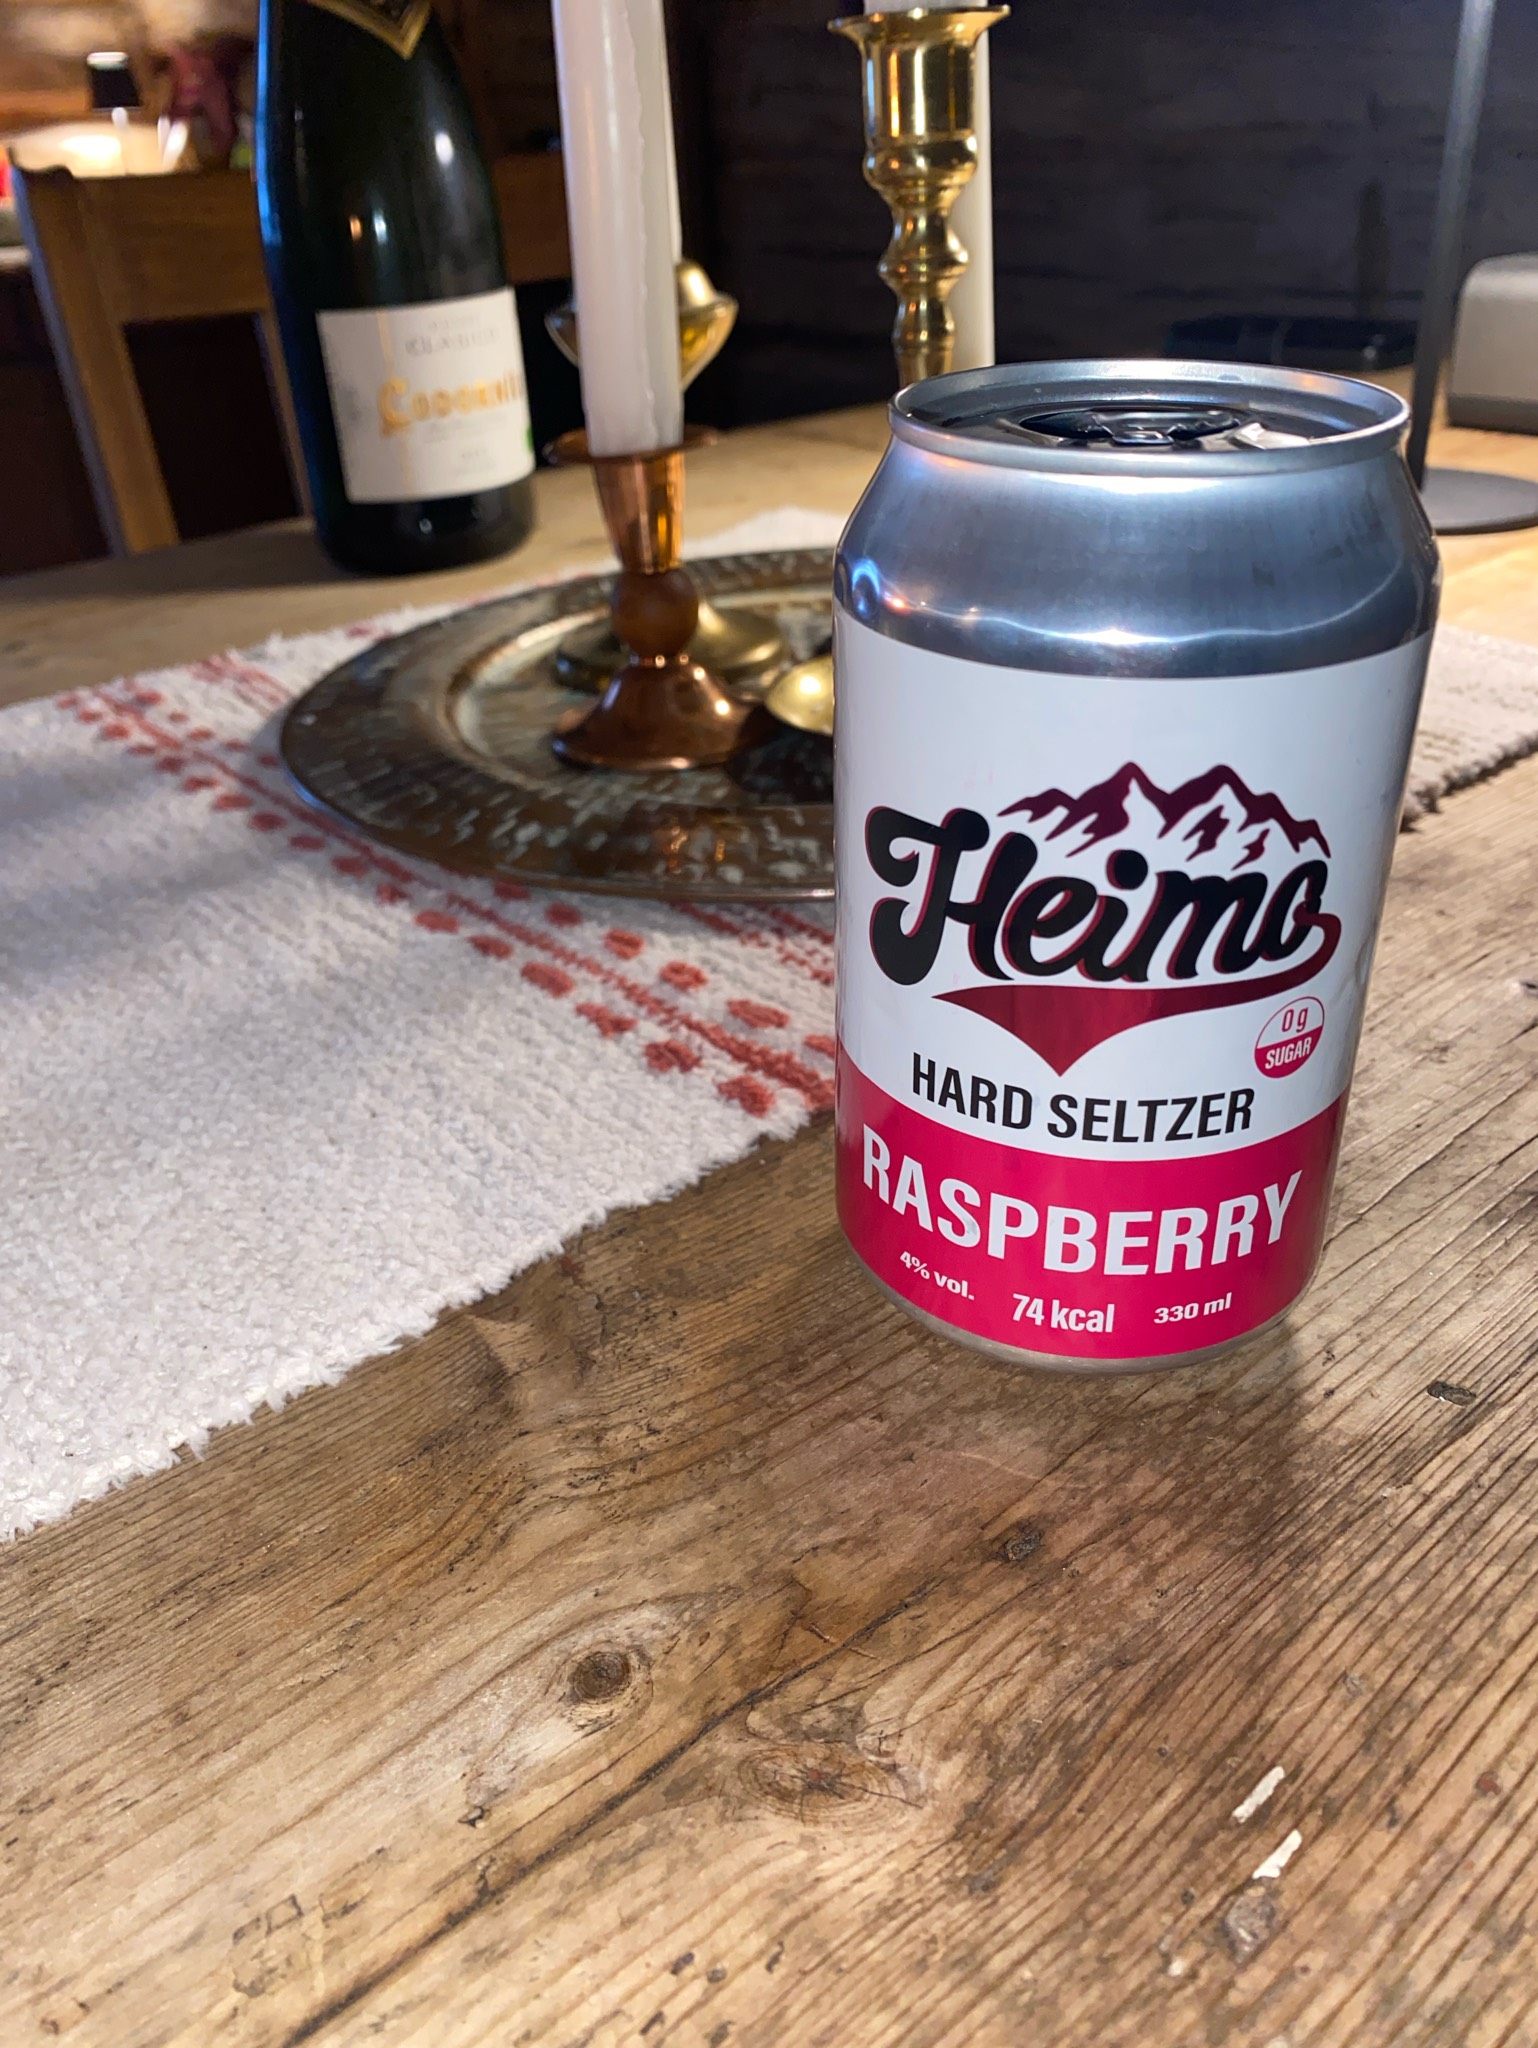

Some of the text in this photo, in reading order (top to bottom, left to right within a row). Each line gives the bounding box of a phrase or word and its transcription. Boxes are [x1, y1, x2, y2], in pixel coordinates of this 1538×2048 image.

[865, 806, 1332, 985] Heimo
[1296, 1007, 1309, 1033] g
[1265, 1036, 1312, 1070] SUGAR
[912, 1053, 1255, 1143] HARD SELTZER
[863, 1125, 1303, 1276] RASPBERRY
[900, 1251, 976, 1301] 4% vol.
[1012, 1293, 1116, 1334] 74 kcal
[1153, 1292, 1233, 1325] 330 ml
